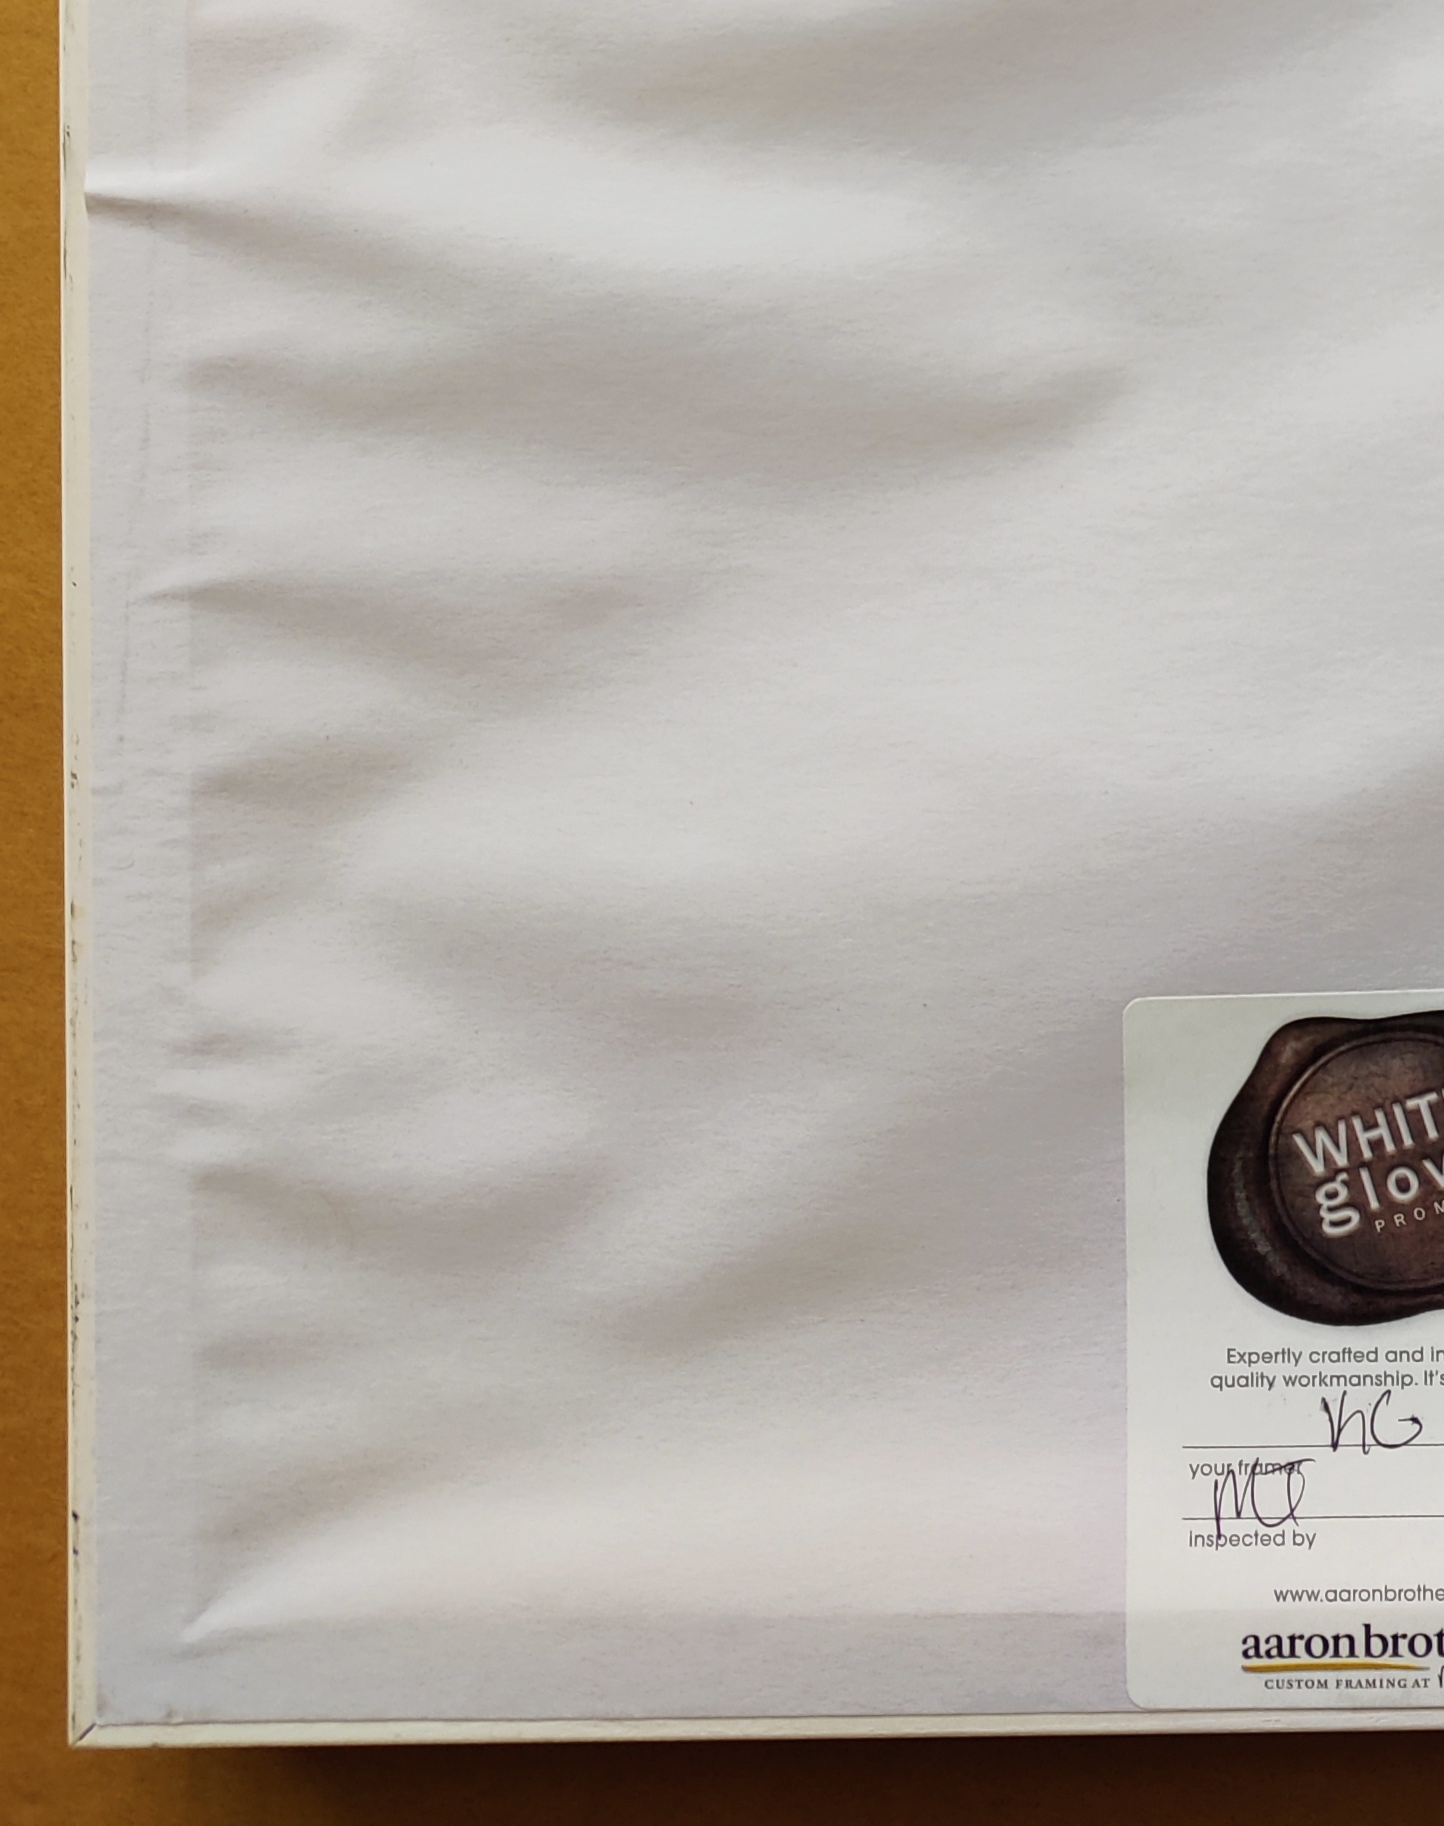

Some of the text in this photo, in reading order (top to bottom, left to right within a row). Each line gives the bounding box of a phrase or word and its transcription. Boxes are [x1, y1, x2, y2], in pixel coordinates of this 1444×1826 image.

[1226, 1347, 1303, 1368] Expertly
[1308, 1346, 1379, 1364] crafted
[1384, 1345, 1424, 1363] and
[1210, 1371, 1277, 1391] quality
[1282, 1369, 1419, 1390] workmanship.
[1189, 1462, 1232, 1480] your
[1189, 1528, 1317, 1551] inspected by
[1264, 1678, 1330, 1690] CUSTOM
[1335, 1677, 1409, 1690] FRAMING
[1411, 1677, 1431, 1689] AT
